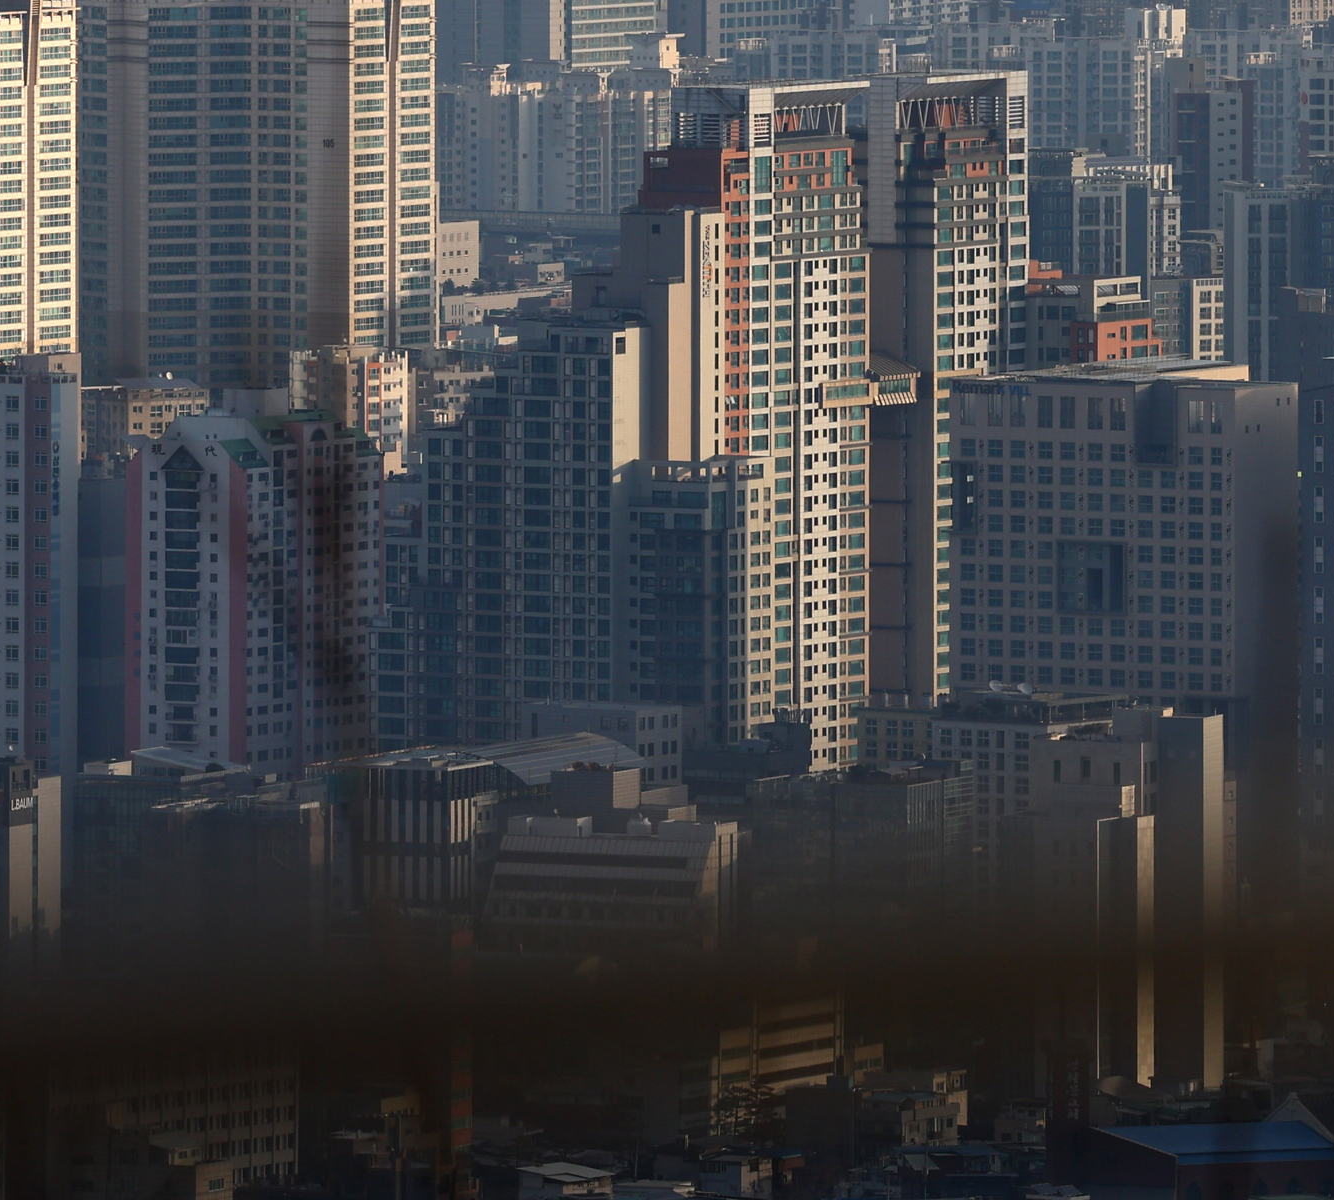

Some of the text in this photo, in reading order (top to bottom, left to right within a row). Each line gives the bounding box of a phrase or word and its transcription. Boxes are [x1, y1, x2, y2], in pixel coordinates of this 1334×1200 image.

[322, 138, 335, 148] 105
[952, 381, 1031, 397] Remark VILL
